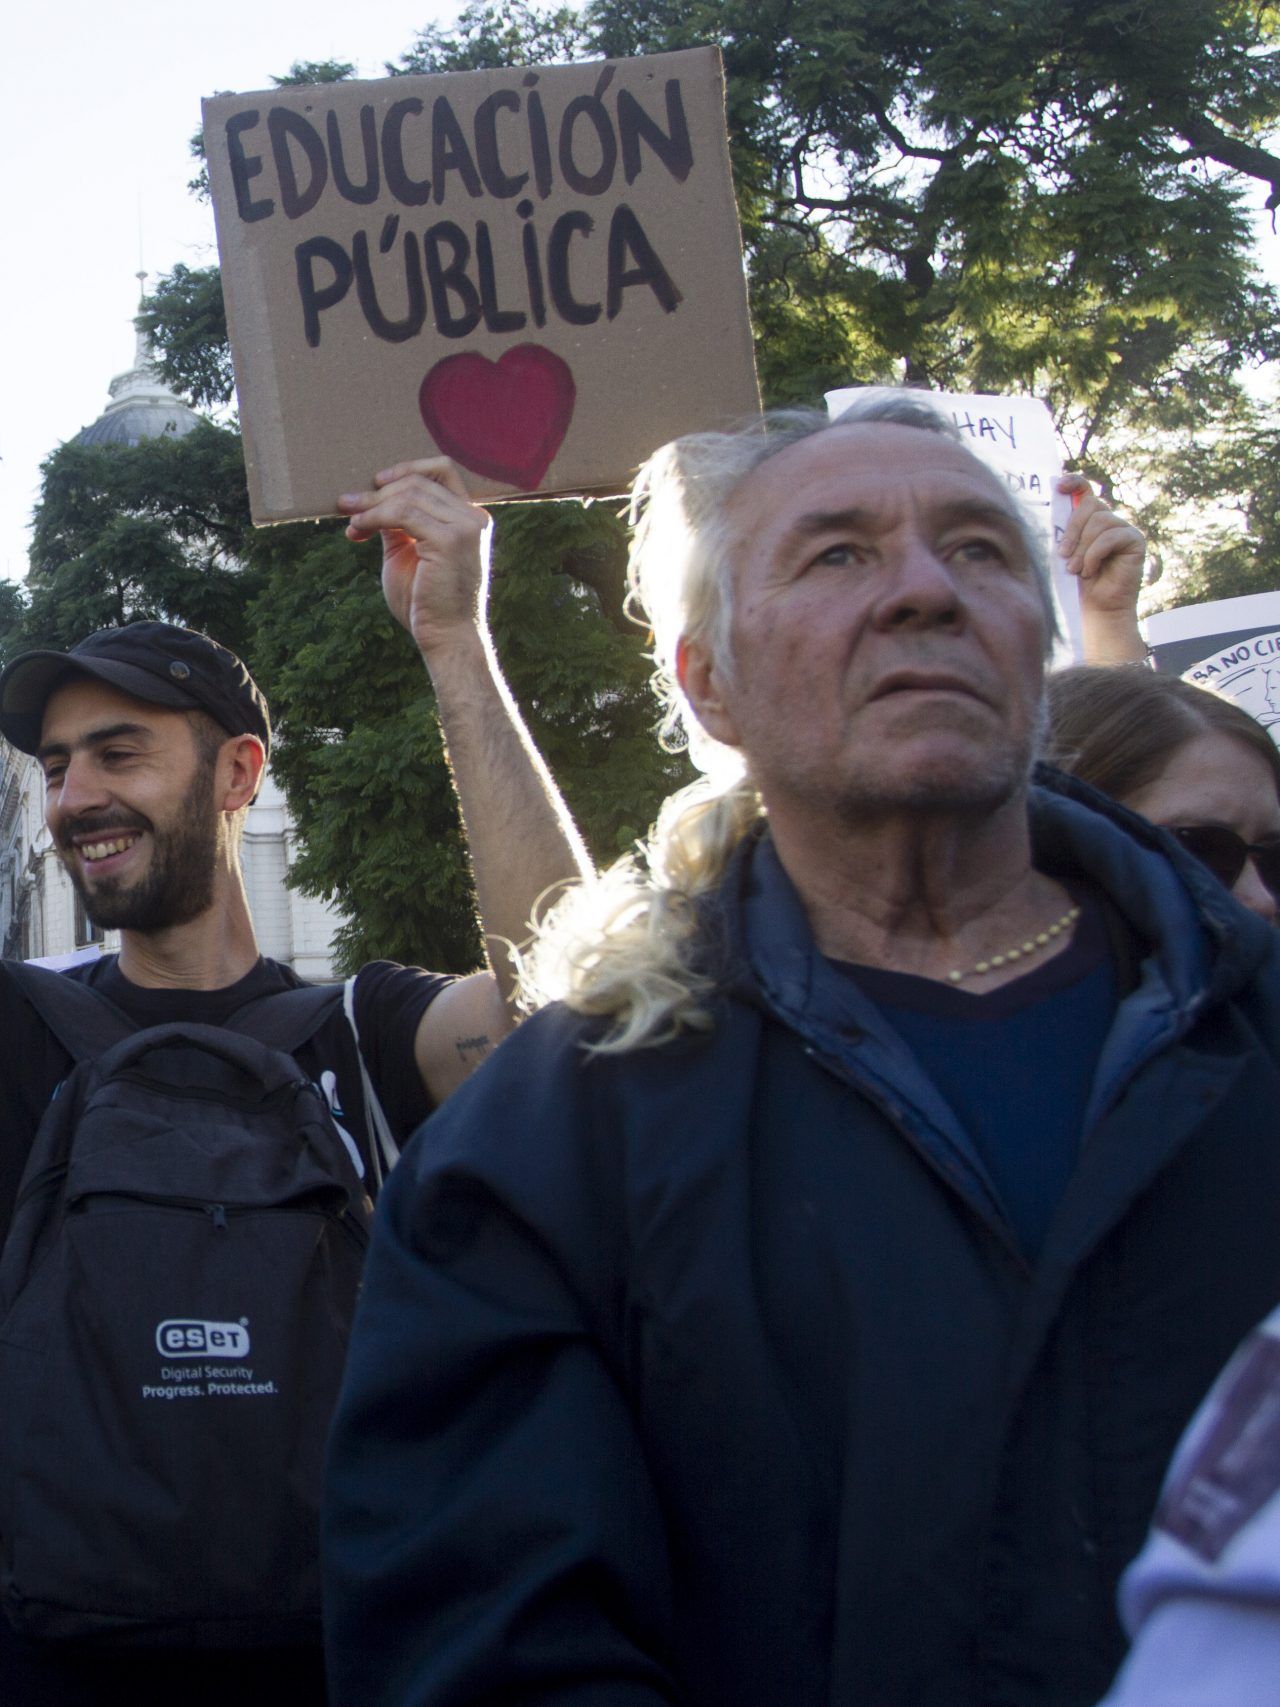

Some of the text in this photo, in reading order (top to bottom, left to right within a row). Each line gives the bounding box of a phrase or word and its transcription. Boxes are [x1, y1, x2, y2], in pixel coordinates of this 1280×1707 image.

[224, 65, 694, 223] EDUCACIÓN
[294, 200, 684, 347] PÚBLICA
[952, 411, 1017, 449] HAY
[1221, 645, 1251, 668] NO
[161, 1366, 254, 1382] Digital Security
[142, 1381, 278, 1399] Progress. Protected.
